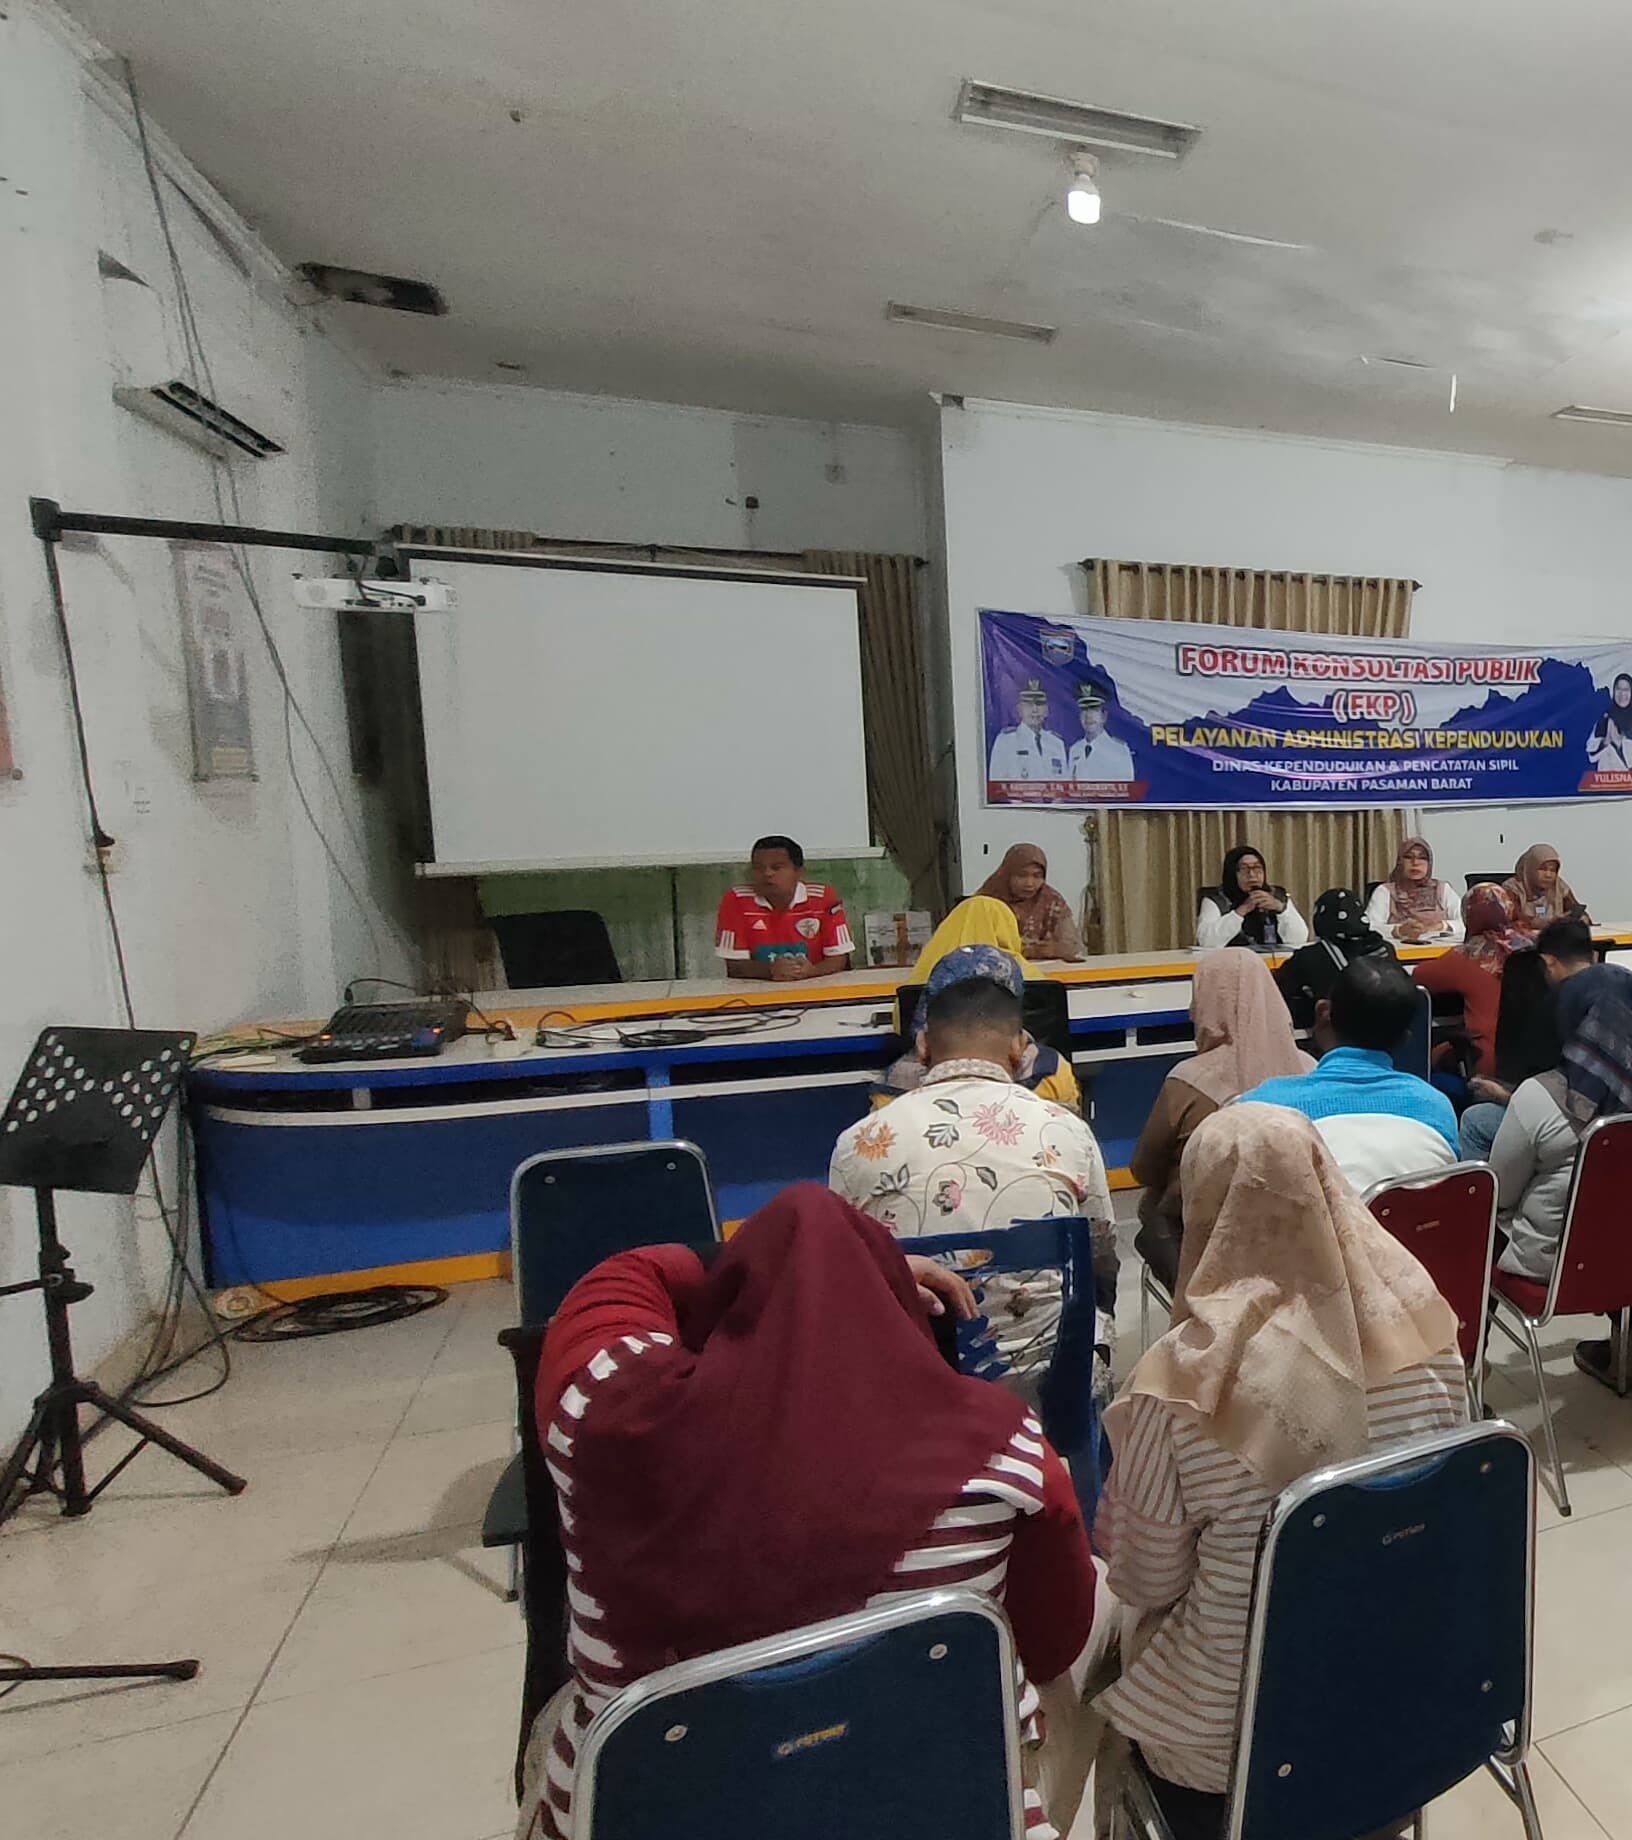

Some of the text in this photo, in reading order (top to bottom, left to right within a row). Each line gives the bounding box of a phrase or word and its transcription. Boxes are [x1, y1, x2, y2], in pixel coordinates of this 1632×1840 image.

[1179, 645, 1541, 683] FORUM KONSULTASI PUBLIK
[1151, 726, 1563, 750] PELAYANAN ADMINISTRASI KEPENDUDUKAN
[1212, 759, 1519, 773] DINAS KEPENDUDUKAN & PENCATATAN SIPIL
[1270, 778, 1473, 792] KABUPATEN PASAMAN BARAT
